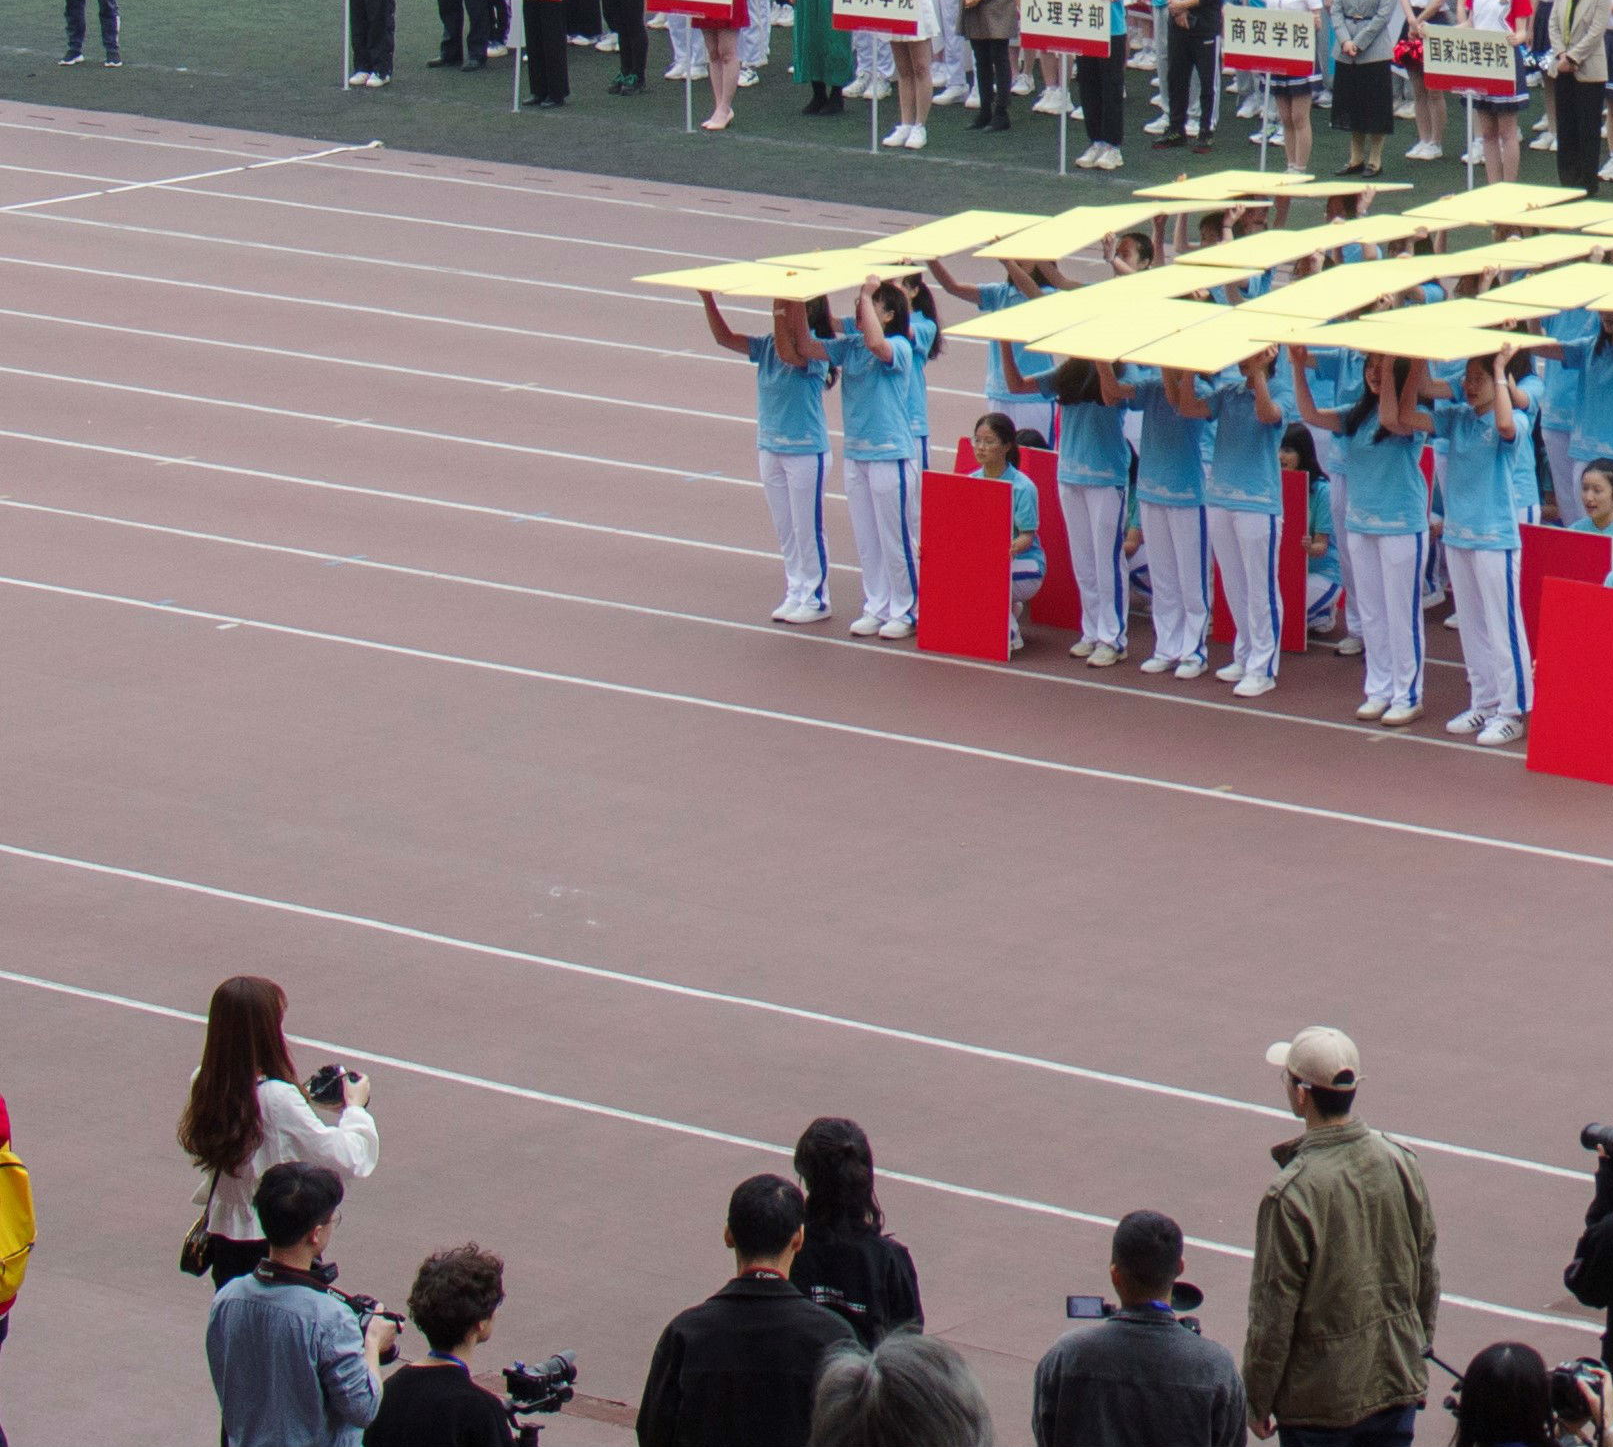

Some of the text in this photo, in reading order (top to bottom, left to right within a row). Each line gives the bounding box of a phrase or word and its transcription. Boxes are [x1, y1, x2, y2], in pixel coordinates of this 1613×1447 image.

[1026, 0, 1105, 29] 心理学部
[1230, 17, 1310, 51] 商贸学院
[1429, 36, 1510, 70] 国家治理学院
